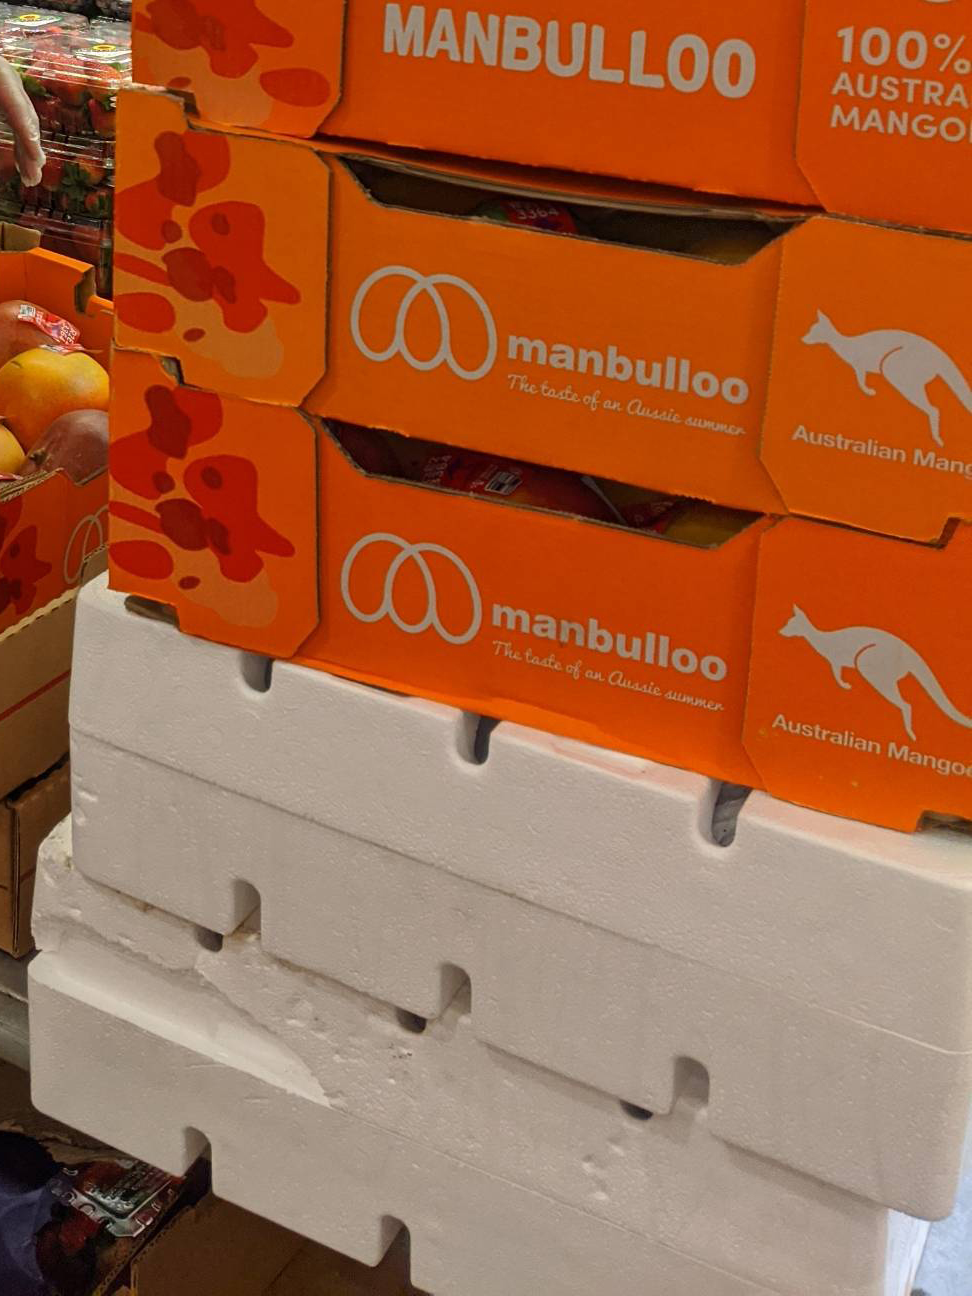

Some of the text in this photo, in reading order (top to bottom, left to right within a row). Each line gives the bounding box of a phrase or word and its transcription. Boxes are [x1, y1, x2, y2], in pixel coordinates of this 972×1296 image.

[383, 3, 756, 98] MANBULLOO
[836, 25, 972, 75] 100%
[831, 71, 970, 109] AUSTRA
[830, 104, 972, 144] MANGO
[507, 334, 750, 404] manbulloo
[507, 373, 745, 436] The taste of an Aussie summer
[792, 424, 906, 463] Australian
[492, 603, 728, 681] manbulloo
[492, 639, 725, 711] The taste of an Aussie summer
[771, 714, 881, 754] Australian
